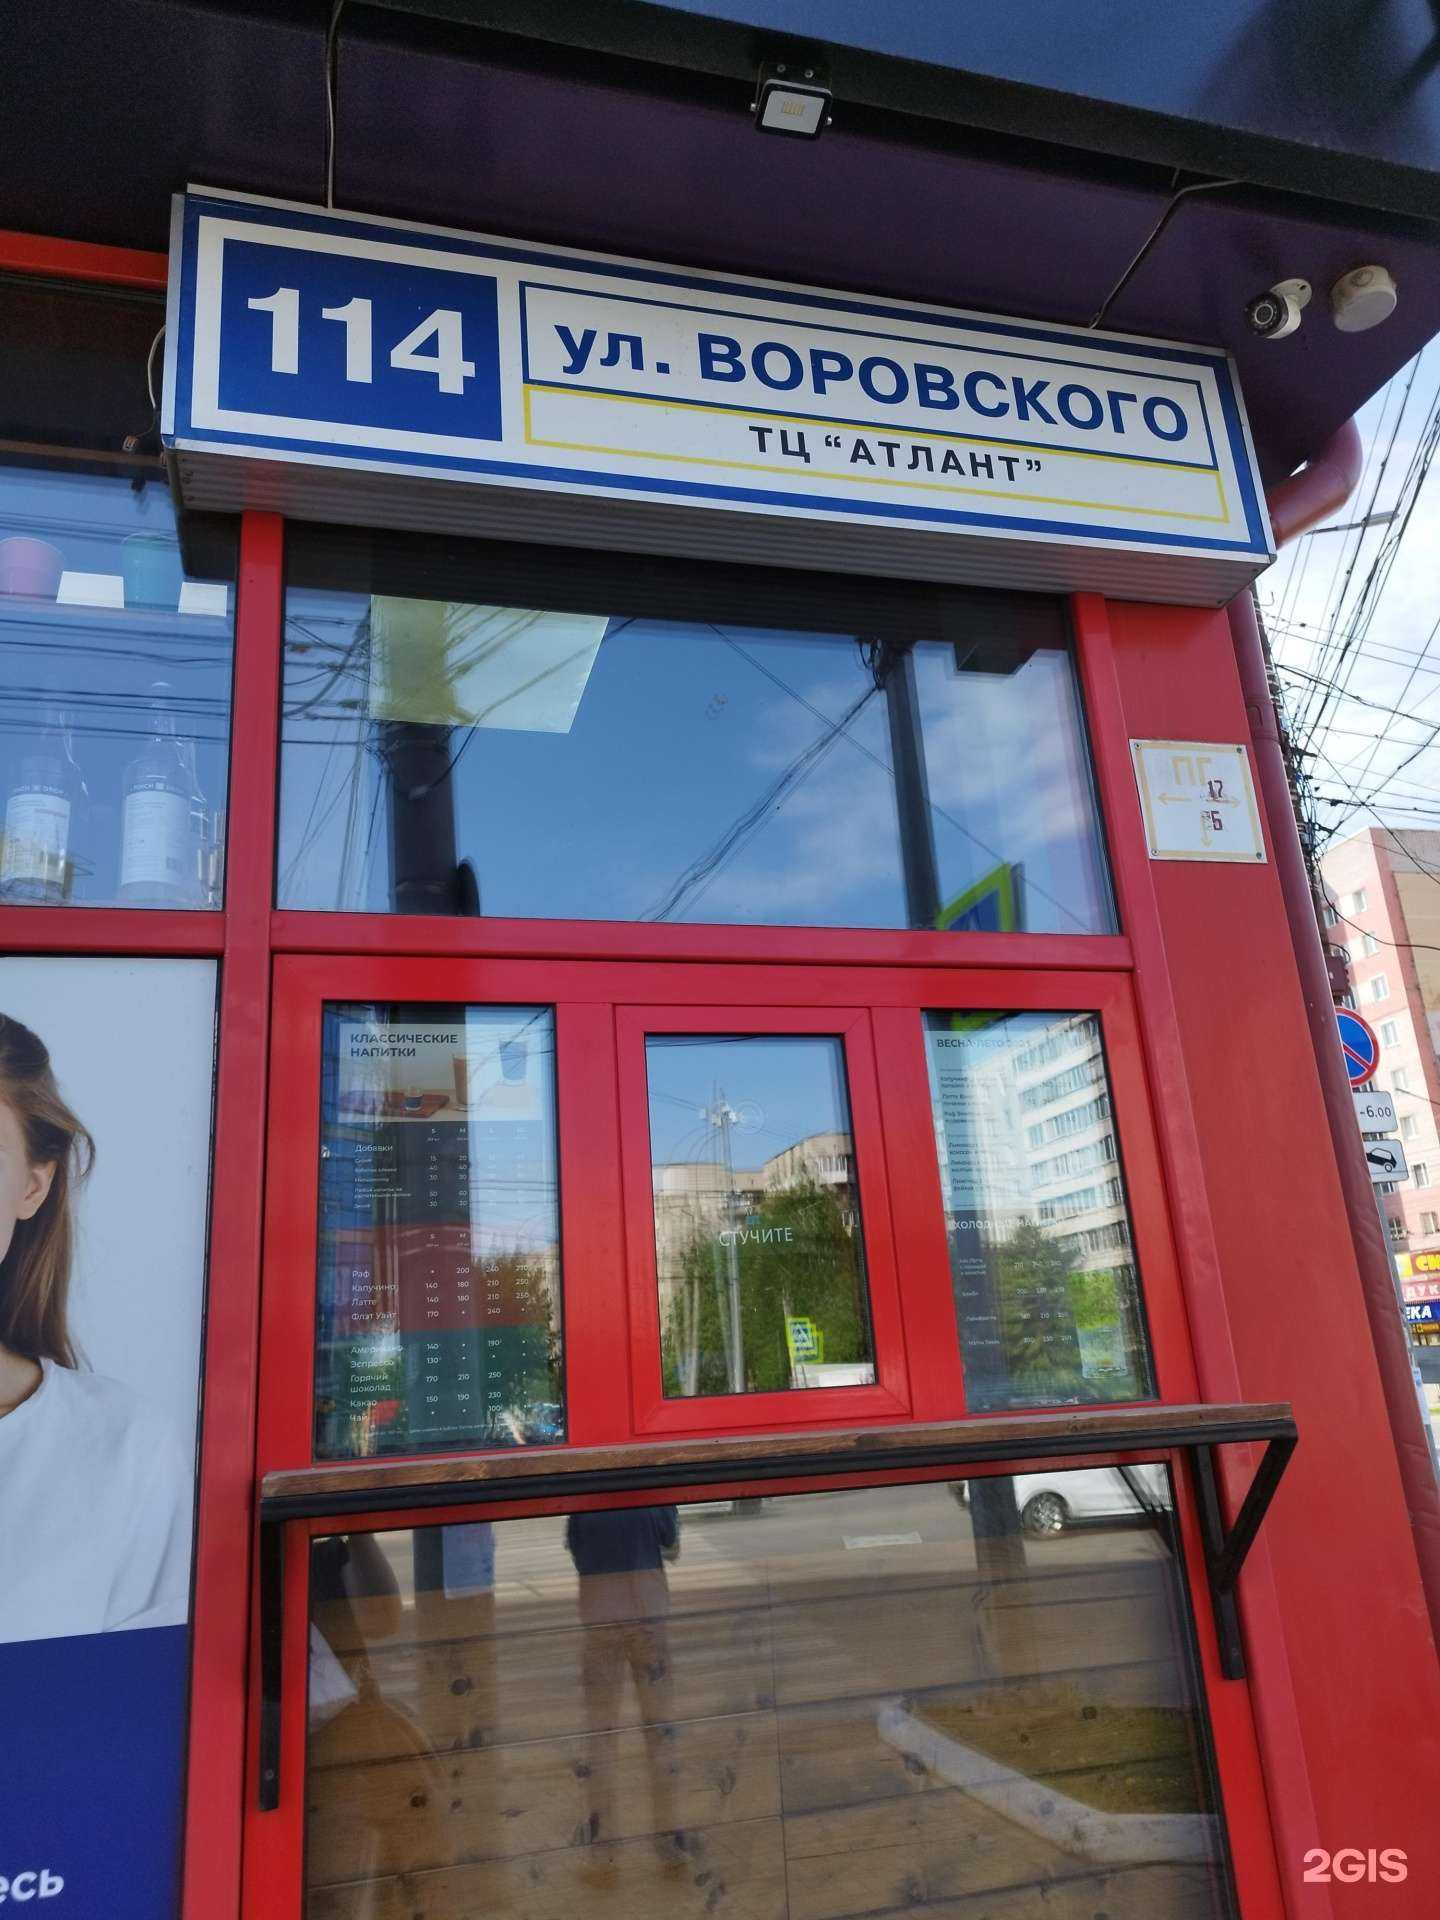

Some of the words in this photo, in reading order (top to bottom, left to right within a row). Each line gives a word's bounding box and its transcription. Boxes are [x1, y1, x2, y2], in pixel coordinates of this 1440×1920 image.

[247, 286, 476, 395] 114
[553, 324, 671, 375] ул.
[697, 332, 1189, 442] ВОРОВСКОГО
[748, 424, 812, 464] ТЦ
[823, 433, 1043, 483] “АТЛАНТ”
[350, 1033, 458, 1044] КЛАССИЧЕСКИЕ
[350, 1047, 416, 1058] НАПИТКИ
[354, 1144, 393, 1153] Добавки
[718, 1227, 794, 1248] СТУЧИТЕ
[352, 1270, 370, 1279] Раф
[350, 1384, 391, 1393] шоколад
